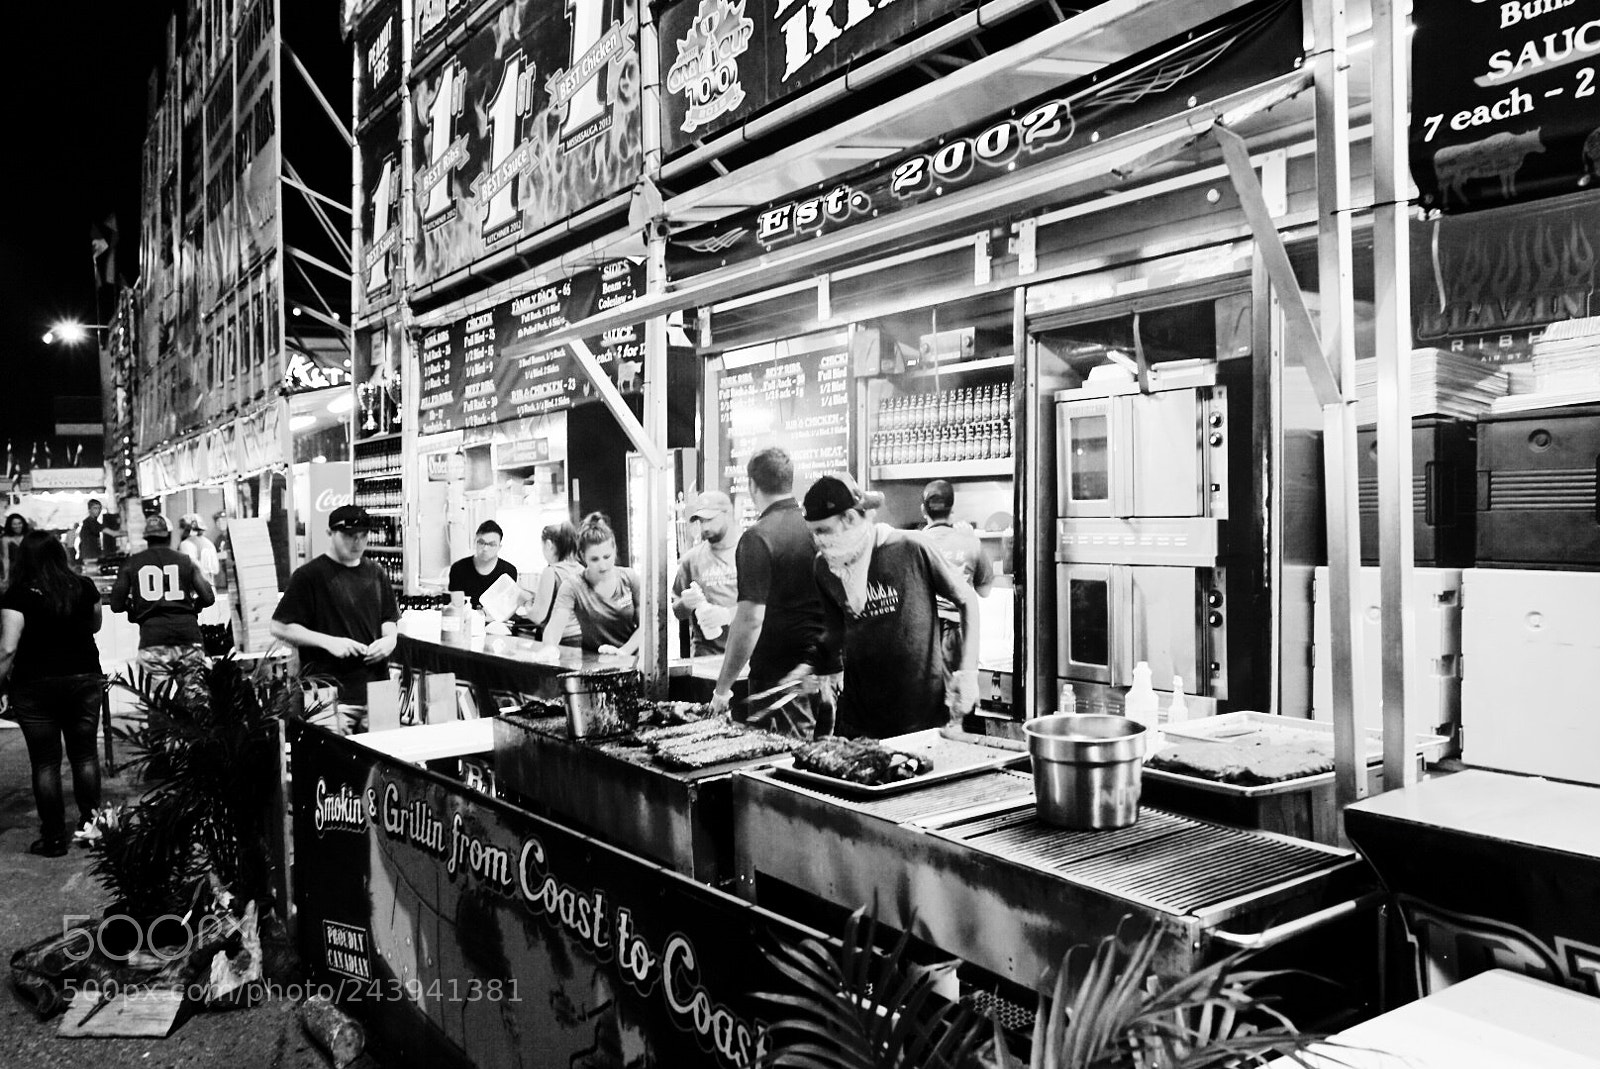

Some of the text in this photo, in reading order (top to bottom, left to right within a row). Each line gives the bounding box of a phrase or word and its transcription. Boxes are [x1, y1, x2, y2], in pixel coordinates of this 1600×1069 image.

[719, 25, 749, 59] CUP
[559, 33, 617, 100] BEST Chicken
[1424, 114, 1444, 142] 7
[1450, 87, 1535, 132] each
[1575, 67, 1597, 99] 2
[422, 164, 442, 190] BEST
[481, 151, 527, 200] BEST Sauce
[758, 102, 1066, 240] Est. 2002
[602, 260, 631, 279] SIDES
[537, 286, 558, 307] PACK
[602, 325, 635, 342] SAUCE
[623, 343, 639, 358] for
[138, 564, 185, 602] 01
[315, 779, 365, 830] Smokin
[367, 788, 377, 817] &
[384, 783, 446, 852] Grillin
[447, 813, 513, 885] from
[519, 838, 609, 948] Coast
[618, 912, 656, 981] to
[327, 926, 364, 953] PROUDLY
[327, 949, 369, 978] CANADIAN
